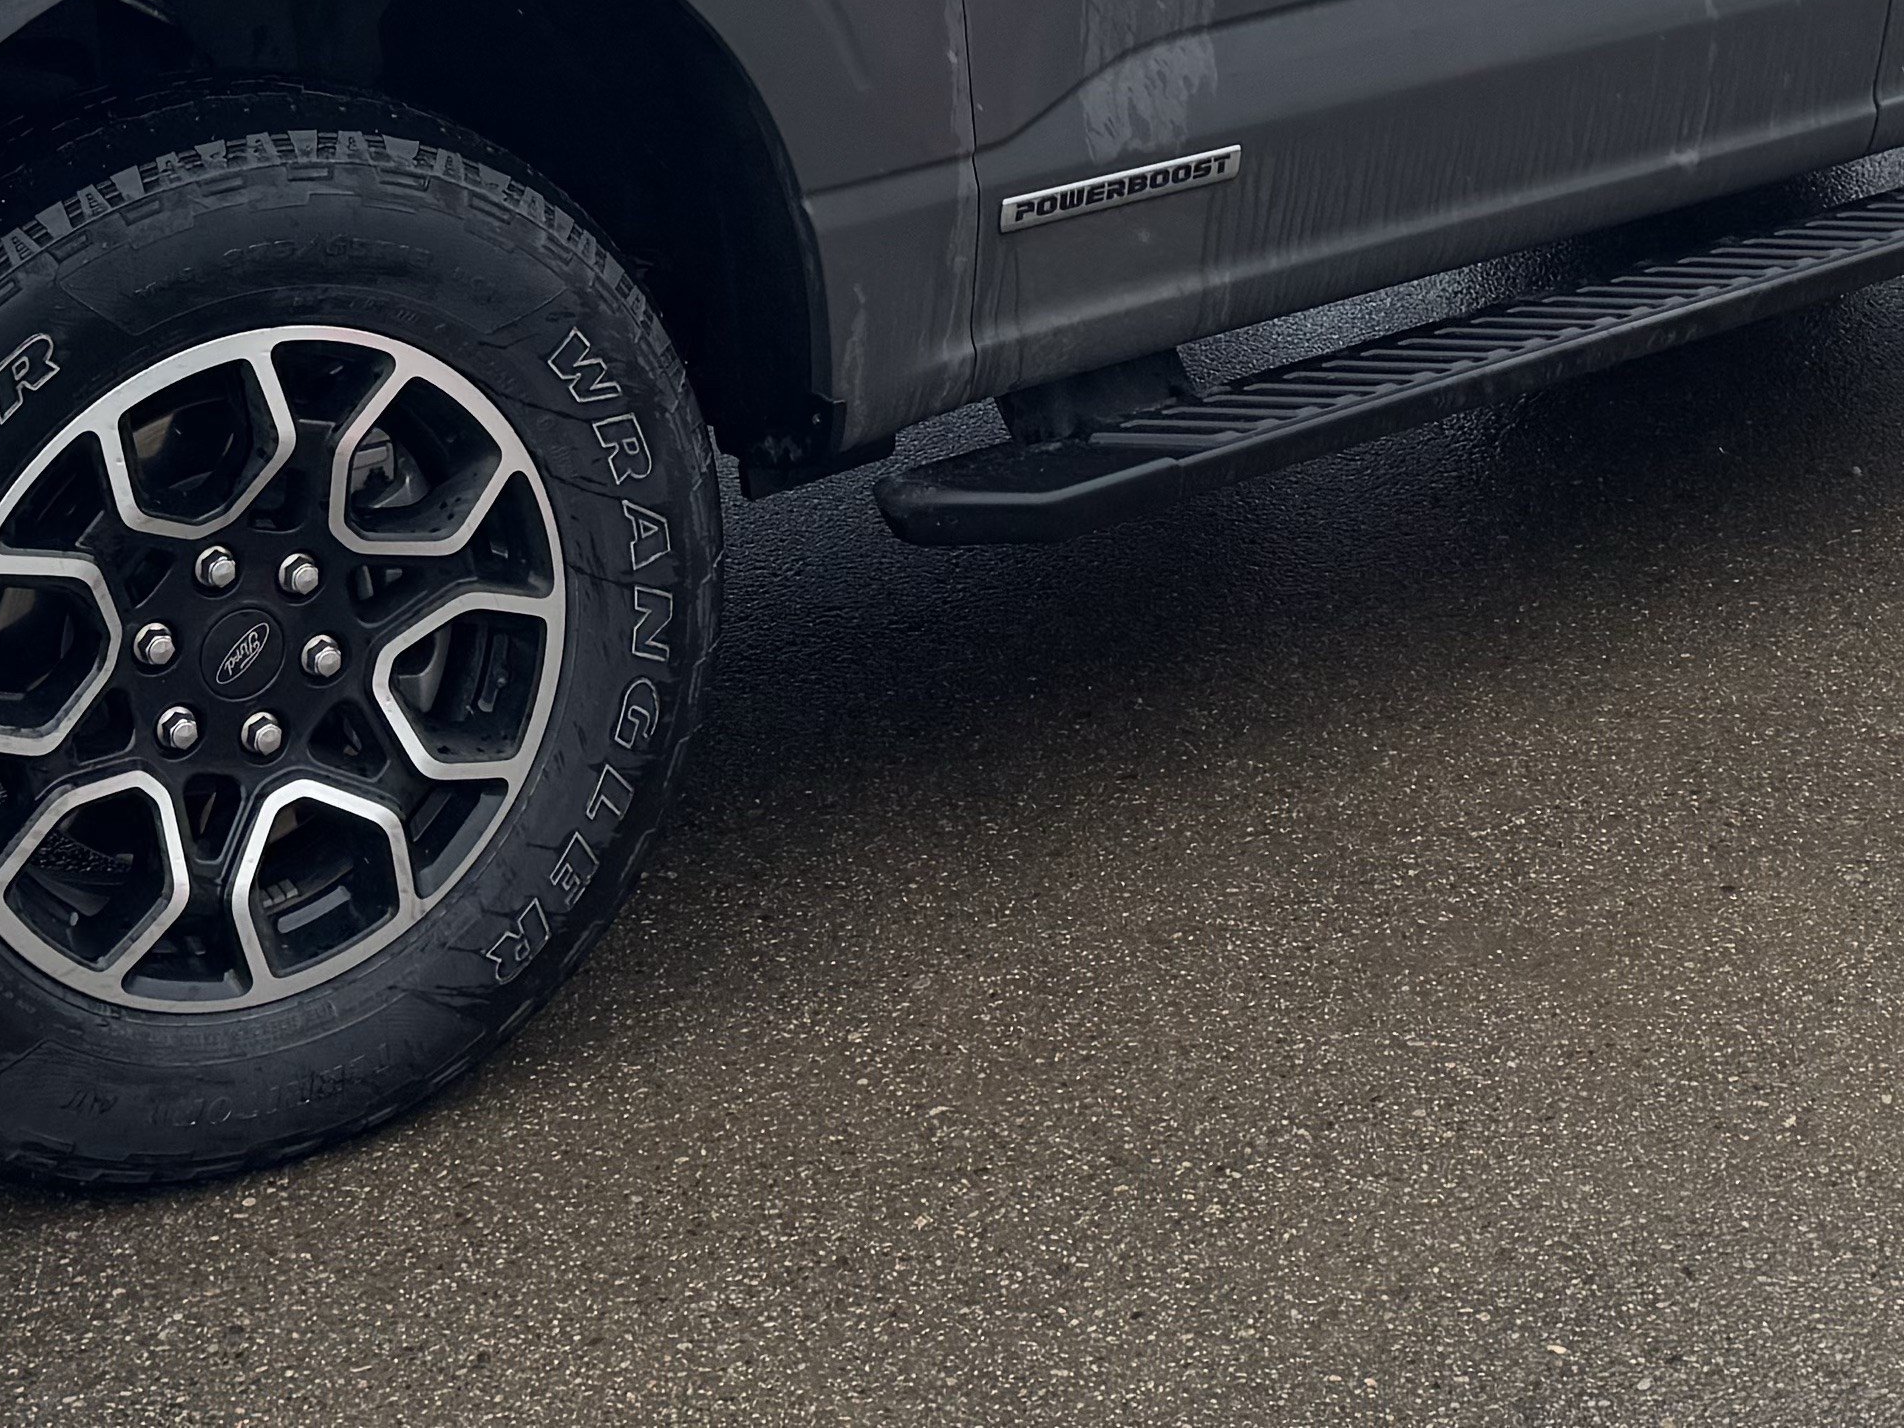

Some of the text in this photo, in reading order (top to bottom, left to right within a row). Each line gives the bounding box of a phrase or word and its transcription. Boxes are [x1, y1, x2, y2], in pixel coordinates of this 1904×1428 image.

[1014, 153, 1231, 222] POWERBOOST
[224, 631, 261, 676] Ford
[485, 327, 673, 986] WRANGLER
